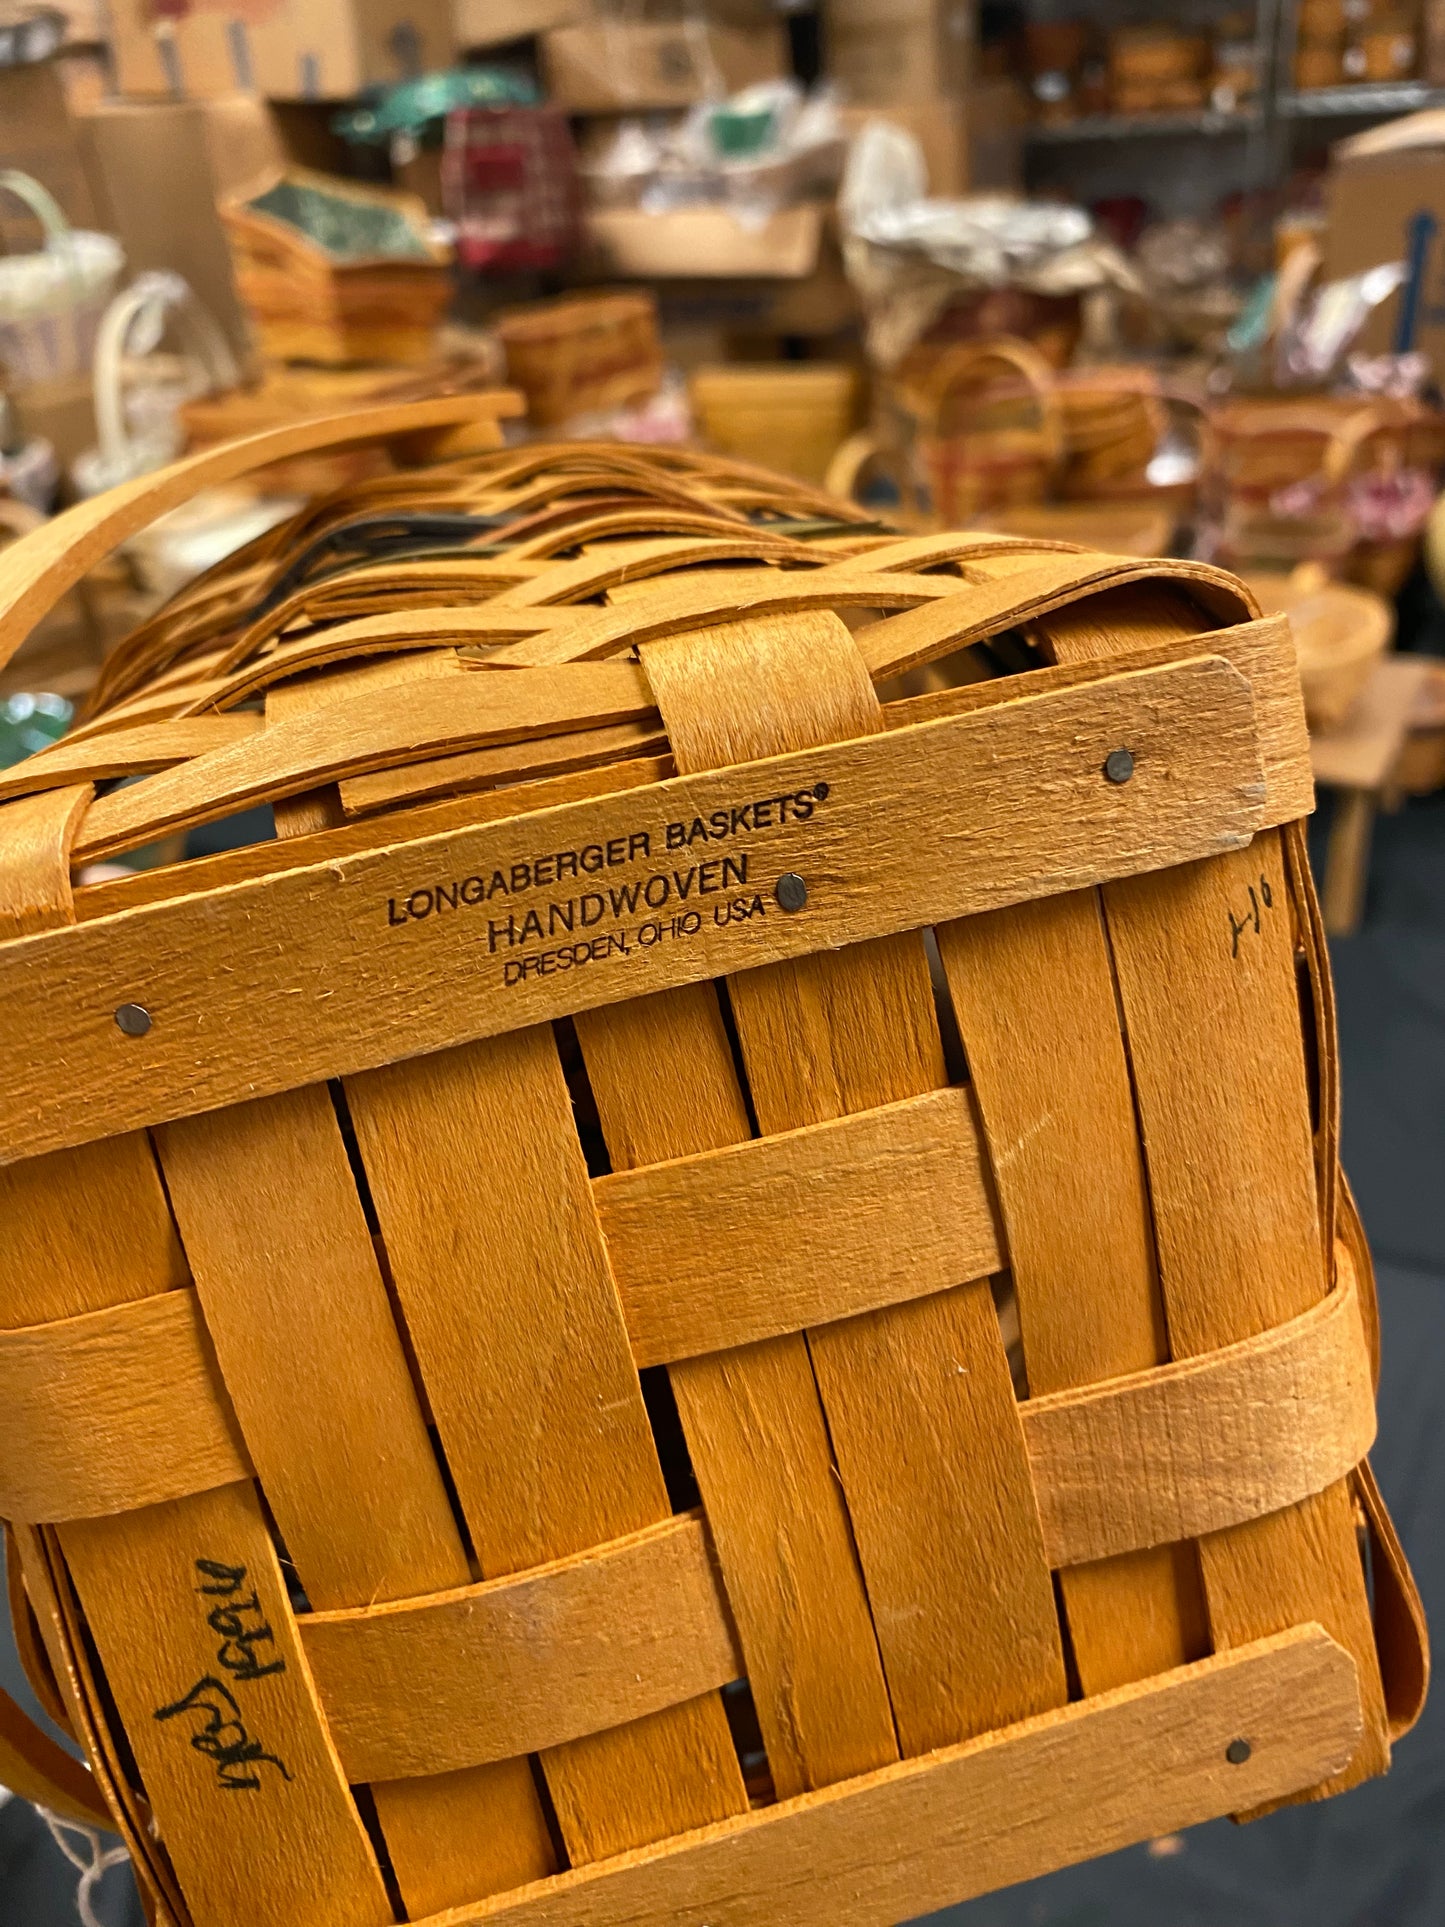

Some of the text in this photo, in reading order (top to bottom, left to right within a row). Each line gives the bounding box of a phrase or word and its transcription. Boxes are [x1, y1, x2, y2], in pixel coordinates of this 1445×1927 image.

[387, 831, 651, 926] LONGABERGER
[487, 853, 748, 953] HANDWOVEN
[503, 894, 767, 987] DRESDEN, OHIO USA
